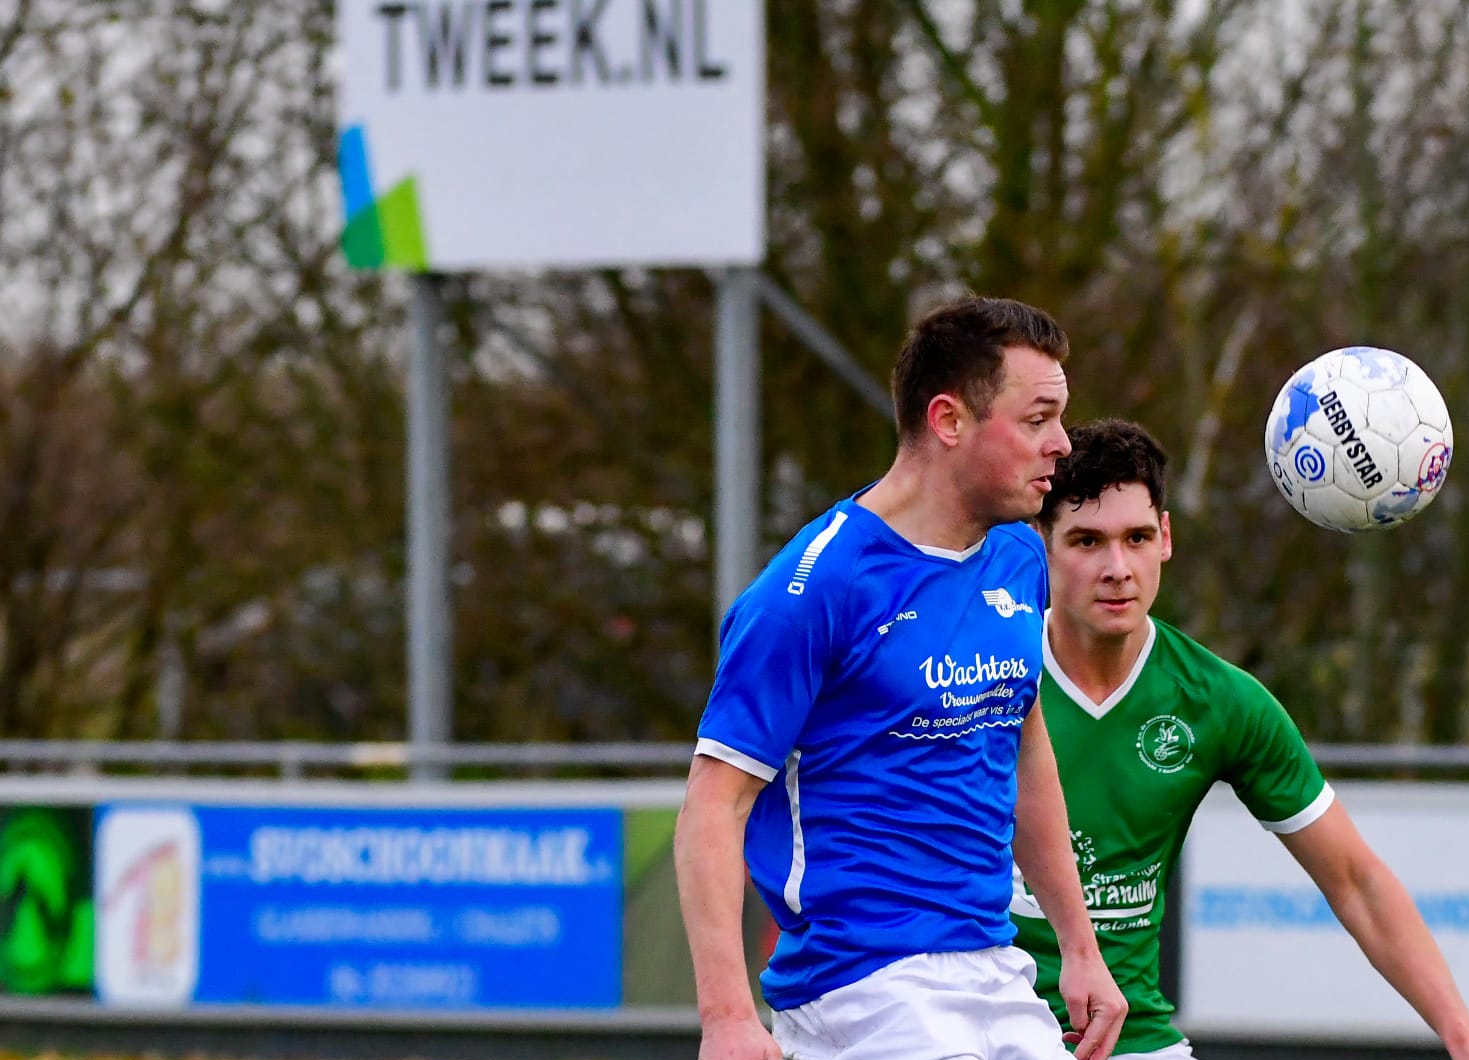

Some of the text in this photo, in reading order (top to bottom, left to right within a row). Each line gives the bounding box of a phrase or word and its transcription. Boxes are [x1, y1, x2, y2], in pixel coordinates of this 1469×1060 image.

[378, 0, 728, 90] TWEEK.NL
[1319, 390, 1383, 489] DERBYSTAR
[919, 653, 1028, 688] Wachters
[912, 716, 930, 728] De
[990, 704, 1004, 716] vis
